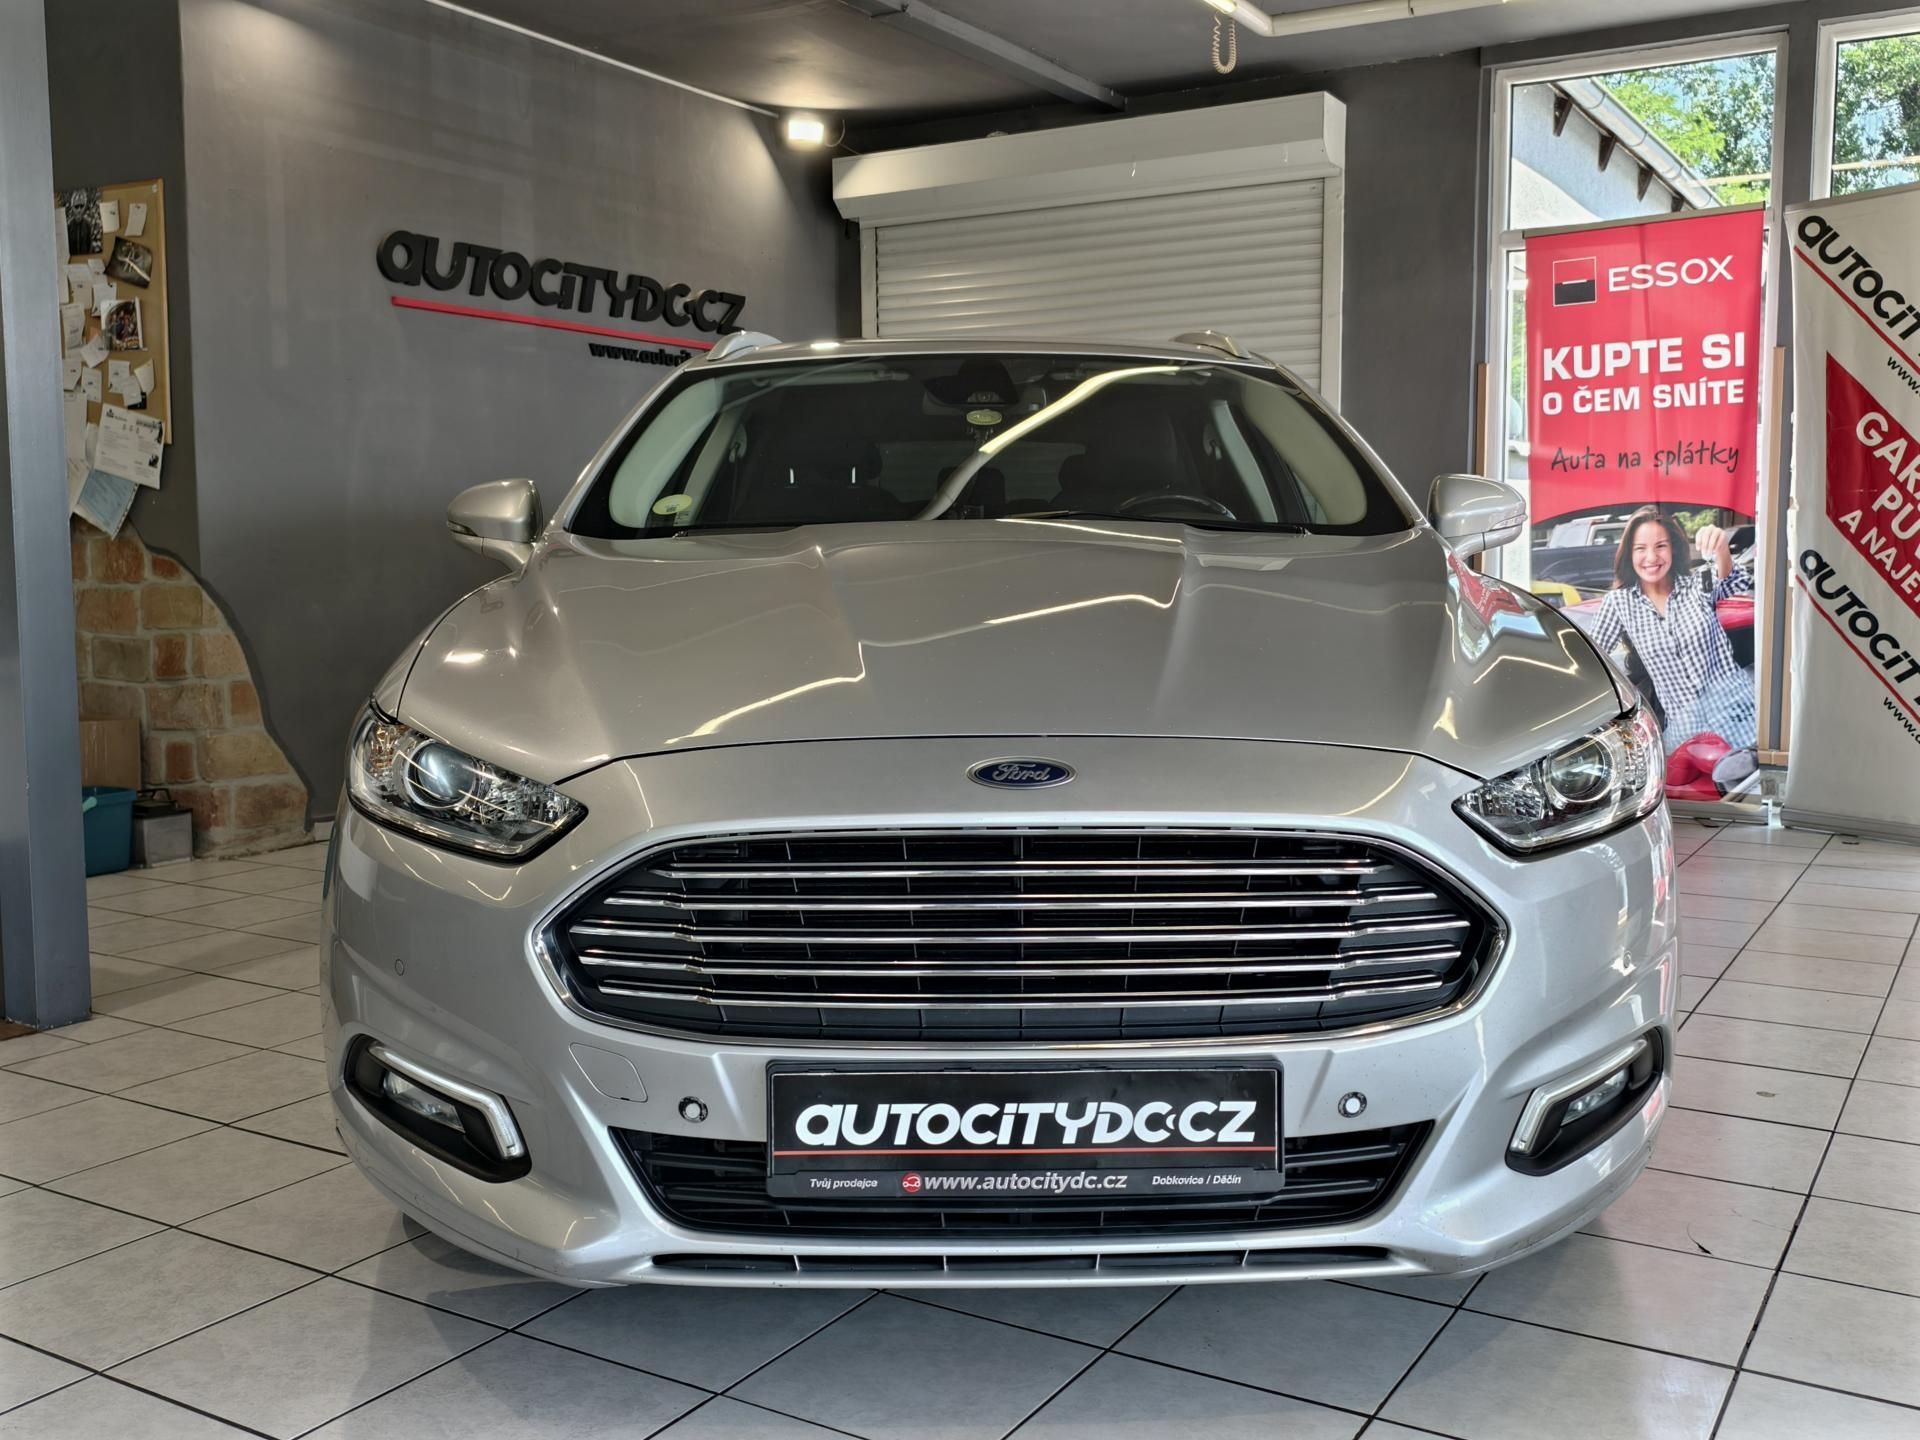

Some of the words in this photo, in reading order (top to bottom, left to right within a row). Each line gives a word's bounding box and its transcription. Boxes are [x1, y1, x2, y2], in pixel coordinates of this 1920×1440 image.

[1608, 255, 1734, 292] ESSOX
[1543, 337, 1683, 381] KUPTE
[1702, 331, 1745, 369] SI
[1542, 392, 1563, 415] O
[1573, 385, 1640, 414] ČEM
[1653, 376, 1744, 409] SNÍTE
[1551, 446, 1605, 473] Auta
[1618, 453, 1641, 469] na
[1653, 440, 1739, 475] splátky
[1856, 411, 1920, 500] GAR
[1839, 509, 1863, 534] A
[1860, 526, 1920, 616] NAJE
[991, 763, 1050, 781] Ford
[810, 1177, 831, 1189] Tvůj
[833, 1177, 878, 1190] prodejce
[924, 1172, 1128, 1193] www.autocitydc.cz
[1152, 1175, 1204, 1185] Dobkovice
[1213, 1174, 1242, 1185] Děčín
